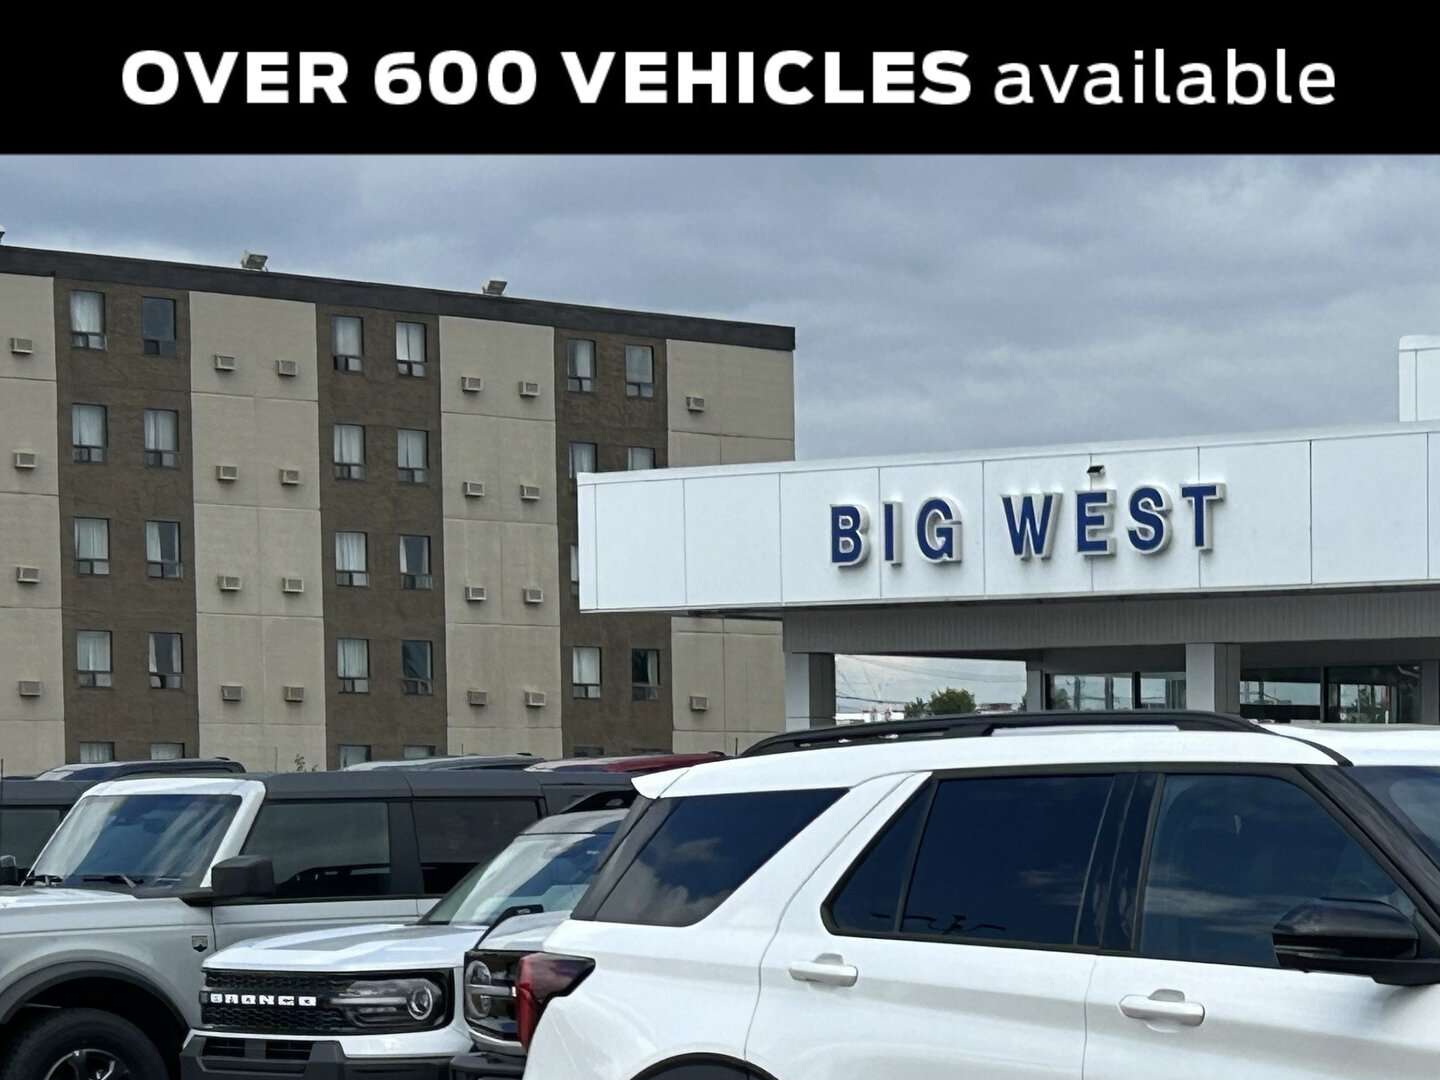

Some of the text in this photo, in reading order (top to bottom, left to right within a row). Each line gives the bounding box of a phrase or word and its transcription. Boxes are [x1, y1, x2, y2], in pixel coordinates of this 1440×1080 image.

[830, 483, 1226, 567] BIG WEST
[210, 993, 317, 1007] BRONCO
